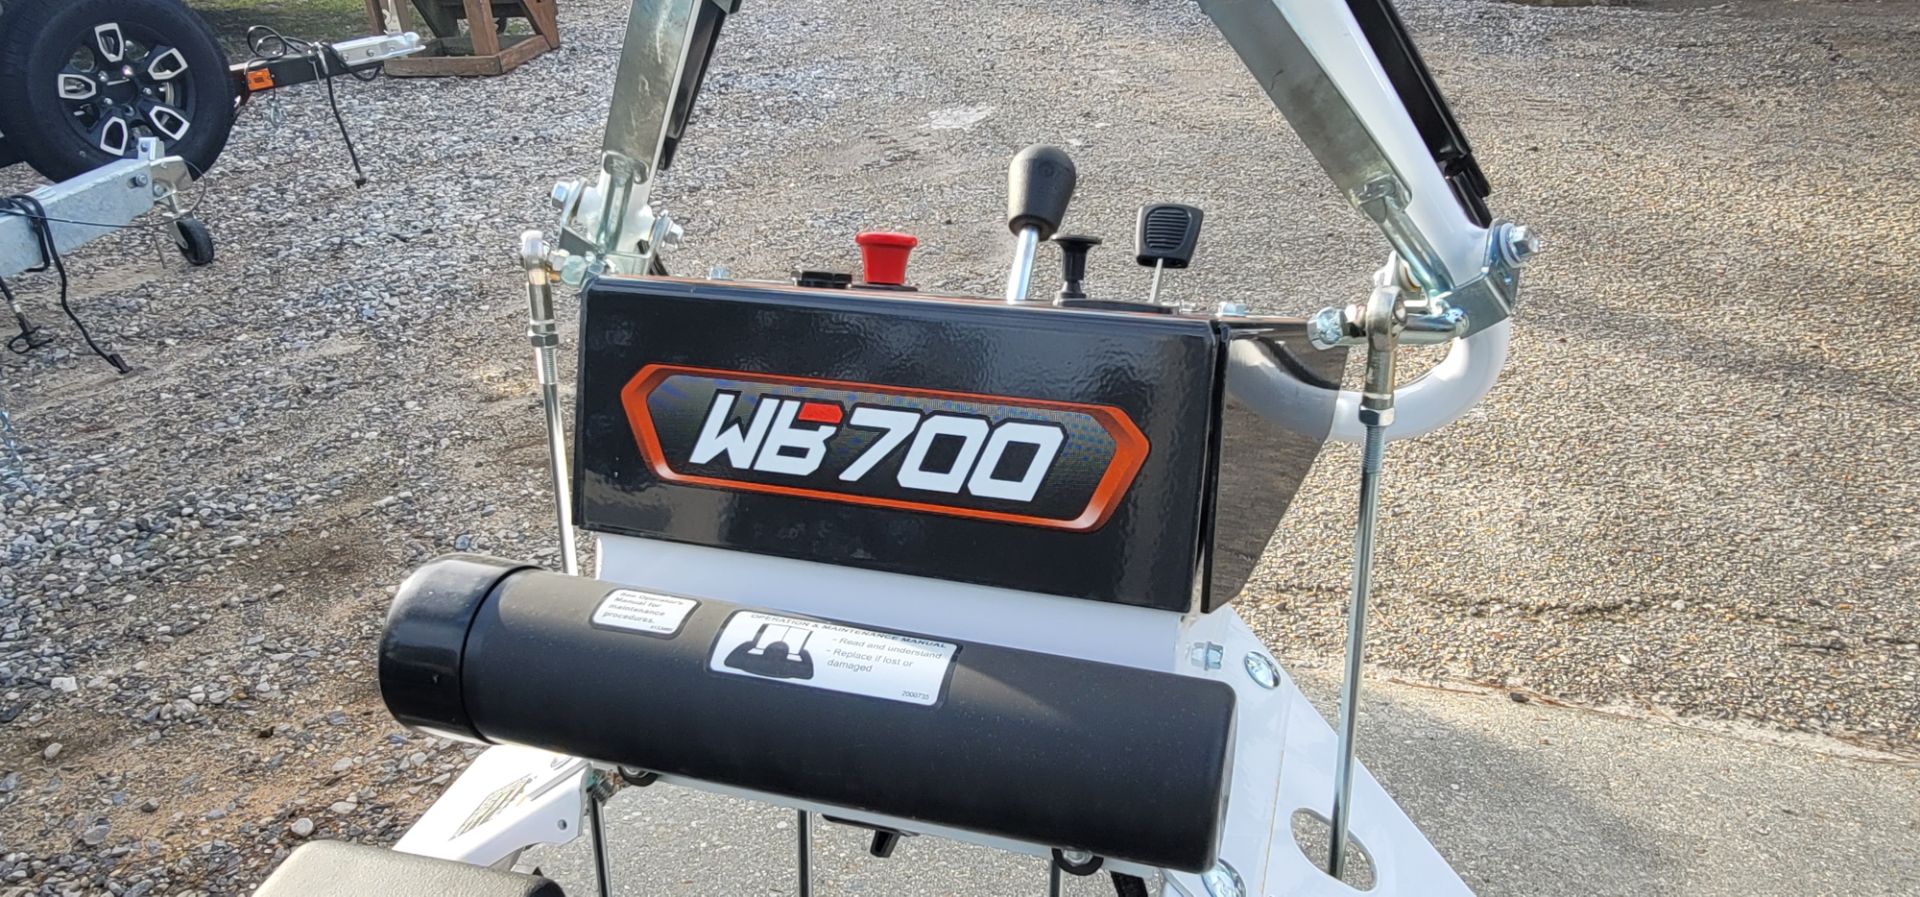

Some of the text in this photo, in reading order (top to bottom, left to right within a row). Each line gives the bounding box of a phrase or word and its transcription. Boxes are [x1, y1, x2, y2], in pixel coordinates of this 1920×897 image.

[615, 597, 647, 606] Manual
[608, 604, 665, 616] maintenance
[602, 611, 655, 623] procedures.
[751, 614, 811, 626] OPERATION
[821, 625, 898, 640] MAINTENANCE
[900, 637, 946, 648] MANUAL
[839, 637, 866, 648] Read
[866, 642, 887, 650] and
[887, 646, 942, 659] understand
[833, 648, 873, 661] Replace
[882, 656, 902, 666] lost
[827, 659, 873, 672] damaged
